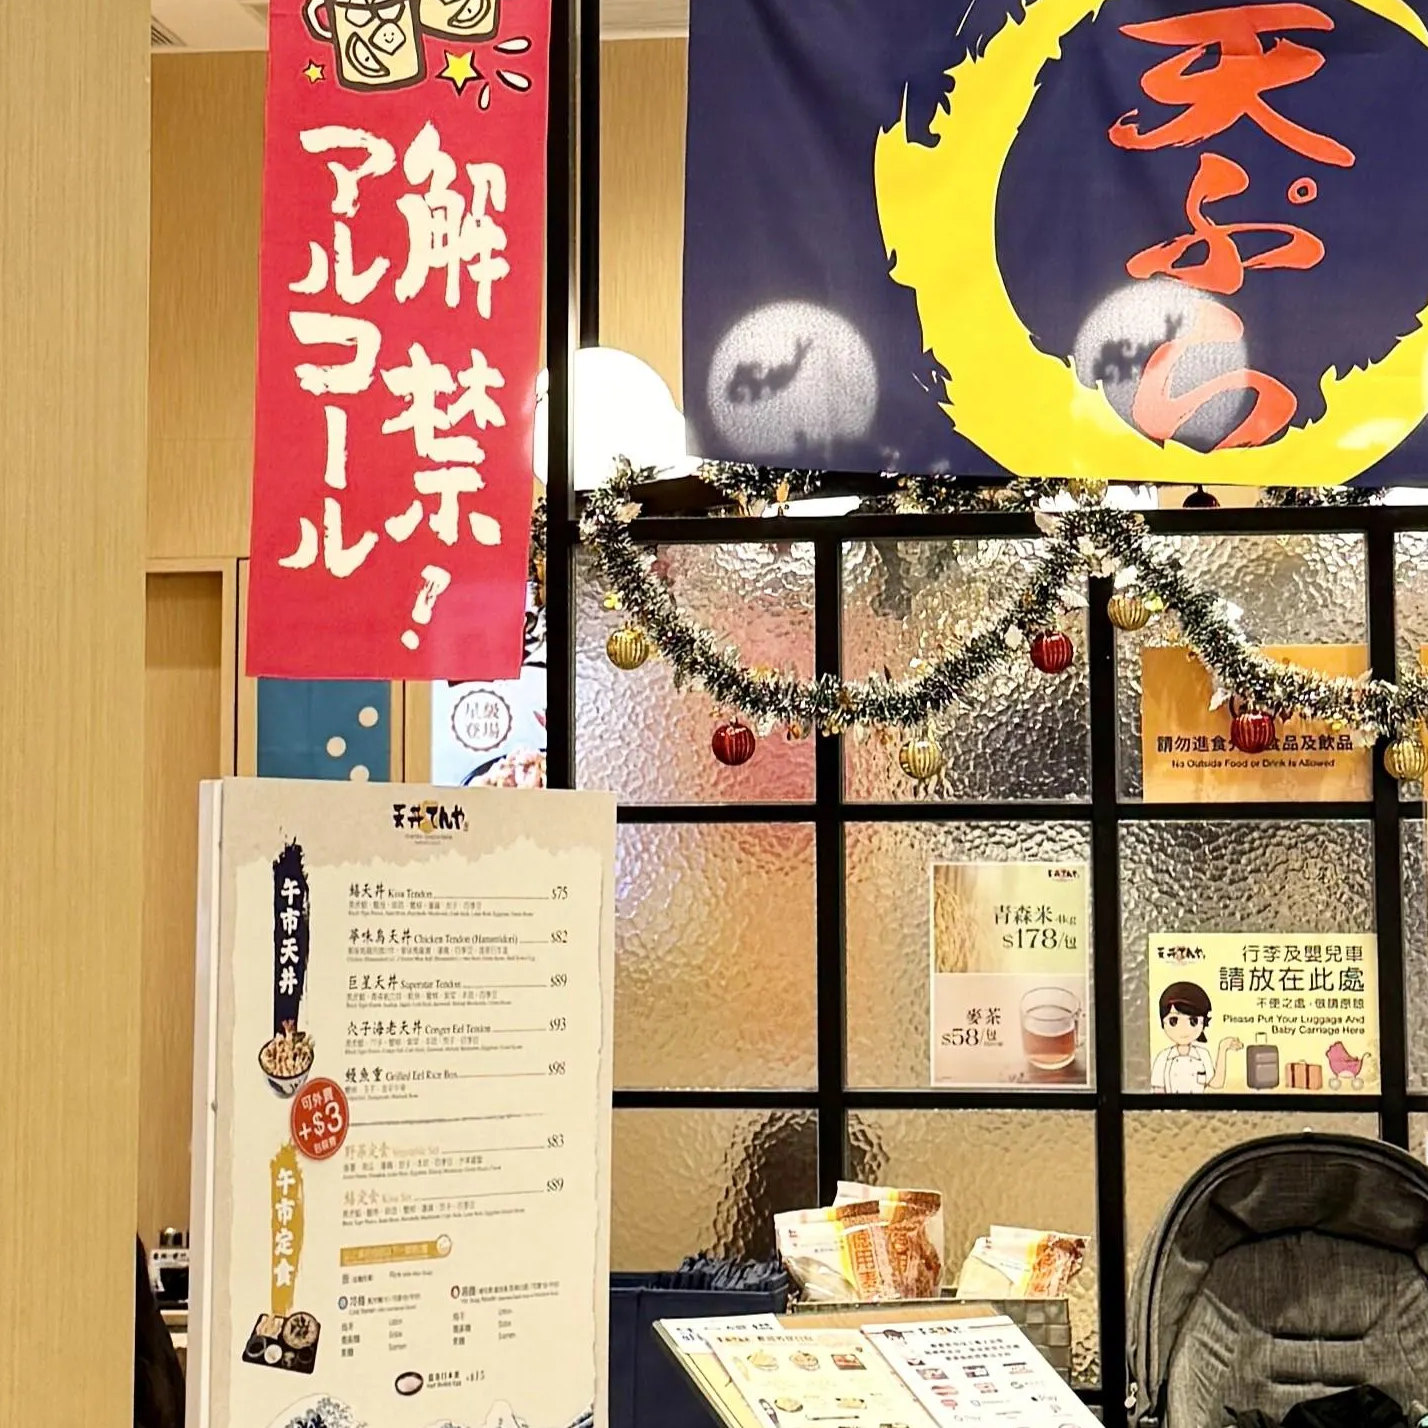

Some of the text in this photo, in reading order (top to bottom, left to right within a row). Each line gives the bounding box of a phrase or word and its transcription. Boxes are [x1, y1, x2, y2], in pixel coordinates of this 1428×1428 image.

[1109, 2, 1355, 452] 天ぷら
[277, 124, 399, 579] アルコール
[1157, 735, 1353, 753] 請勿進食食品及飲品
[1224, 759, 1248, 768] Food
[1250, 759, 1260, 768] or
[1262, 759, 1286, 768] Drink
[1298, 759, 1335, 768] Allowed
[551, 885, 569, 900] $75
[994, 904, 1053, 926] 青森米
[278, 877, 302, 996] 午市天丼
[414, 933, 444, 944] Chicken
[445, 933, 470, 944] Tendon
[551, 930, 568, 944] $82
[1242, 945, 1364, 963] 行李及嬰兒車
[348, 973, 399, 991] 巨星天丼
[550, 973, 568, 988] $89
[1219, 966, 1365, 993] 請放在此處
[347, 1019, 422, 1036] 穴子海老天丼
[452, 1024, 465, 1034] Eel
[549, 1017, 567, 1032] $93
[1223, 1014, 1365, 1026] Please Put Your Luggage And
[1271, 1025, 1365, 1036] Baby Carriage Here
[385, 1071, 411, 1082] Grilled
[412, 1071, 425, 1081] Eel
[426, 1071, 443, 1081] Rice
[444, 1070, 458, 1080] Box
[548, 1061, 566, 1076] $98
[299, 1102, 343, 1142] +$3
[547, 1135, 564, 1149] $83
[546, 1178, 564, 1192] $89
[274, 1168, 296, 1288] 午市定食
